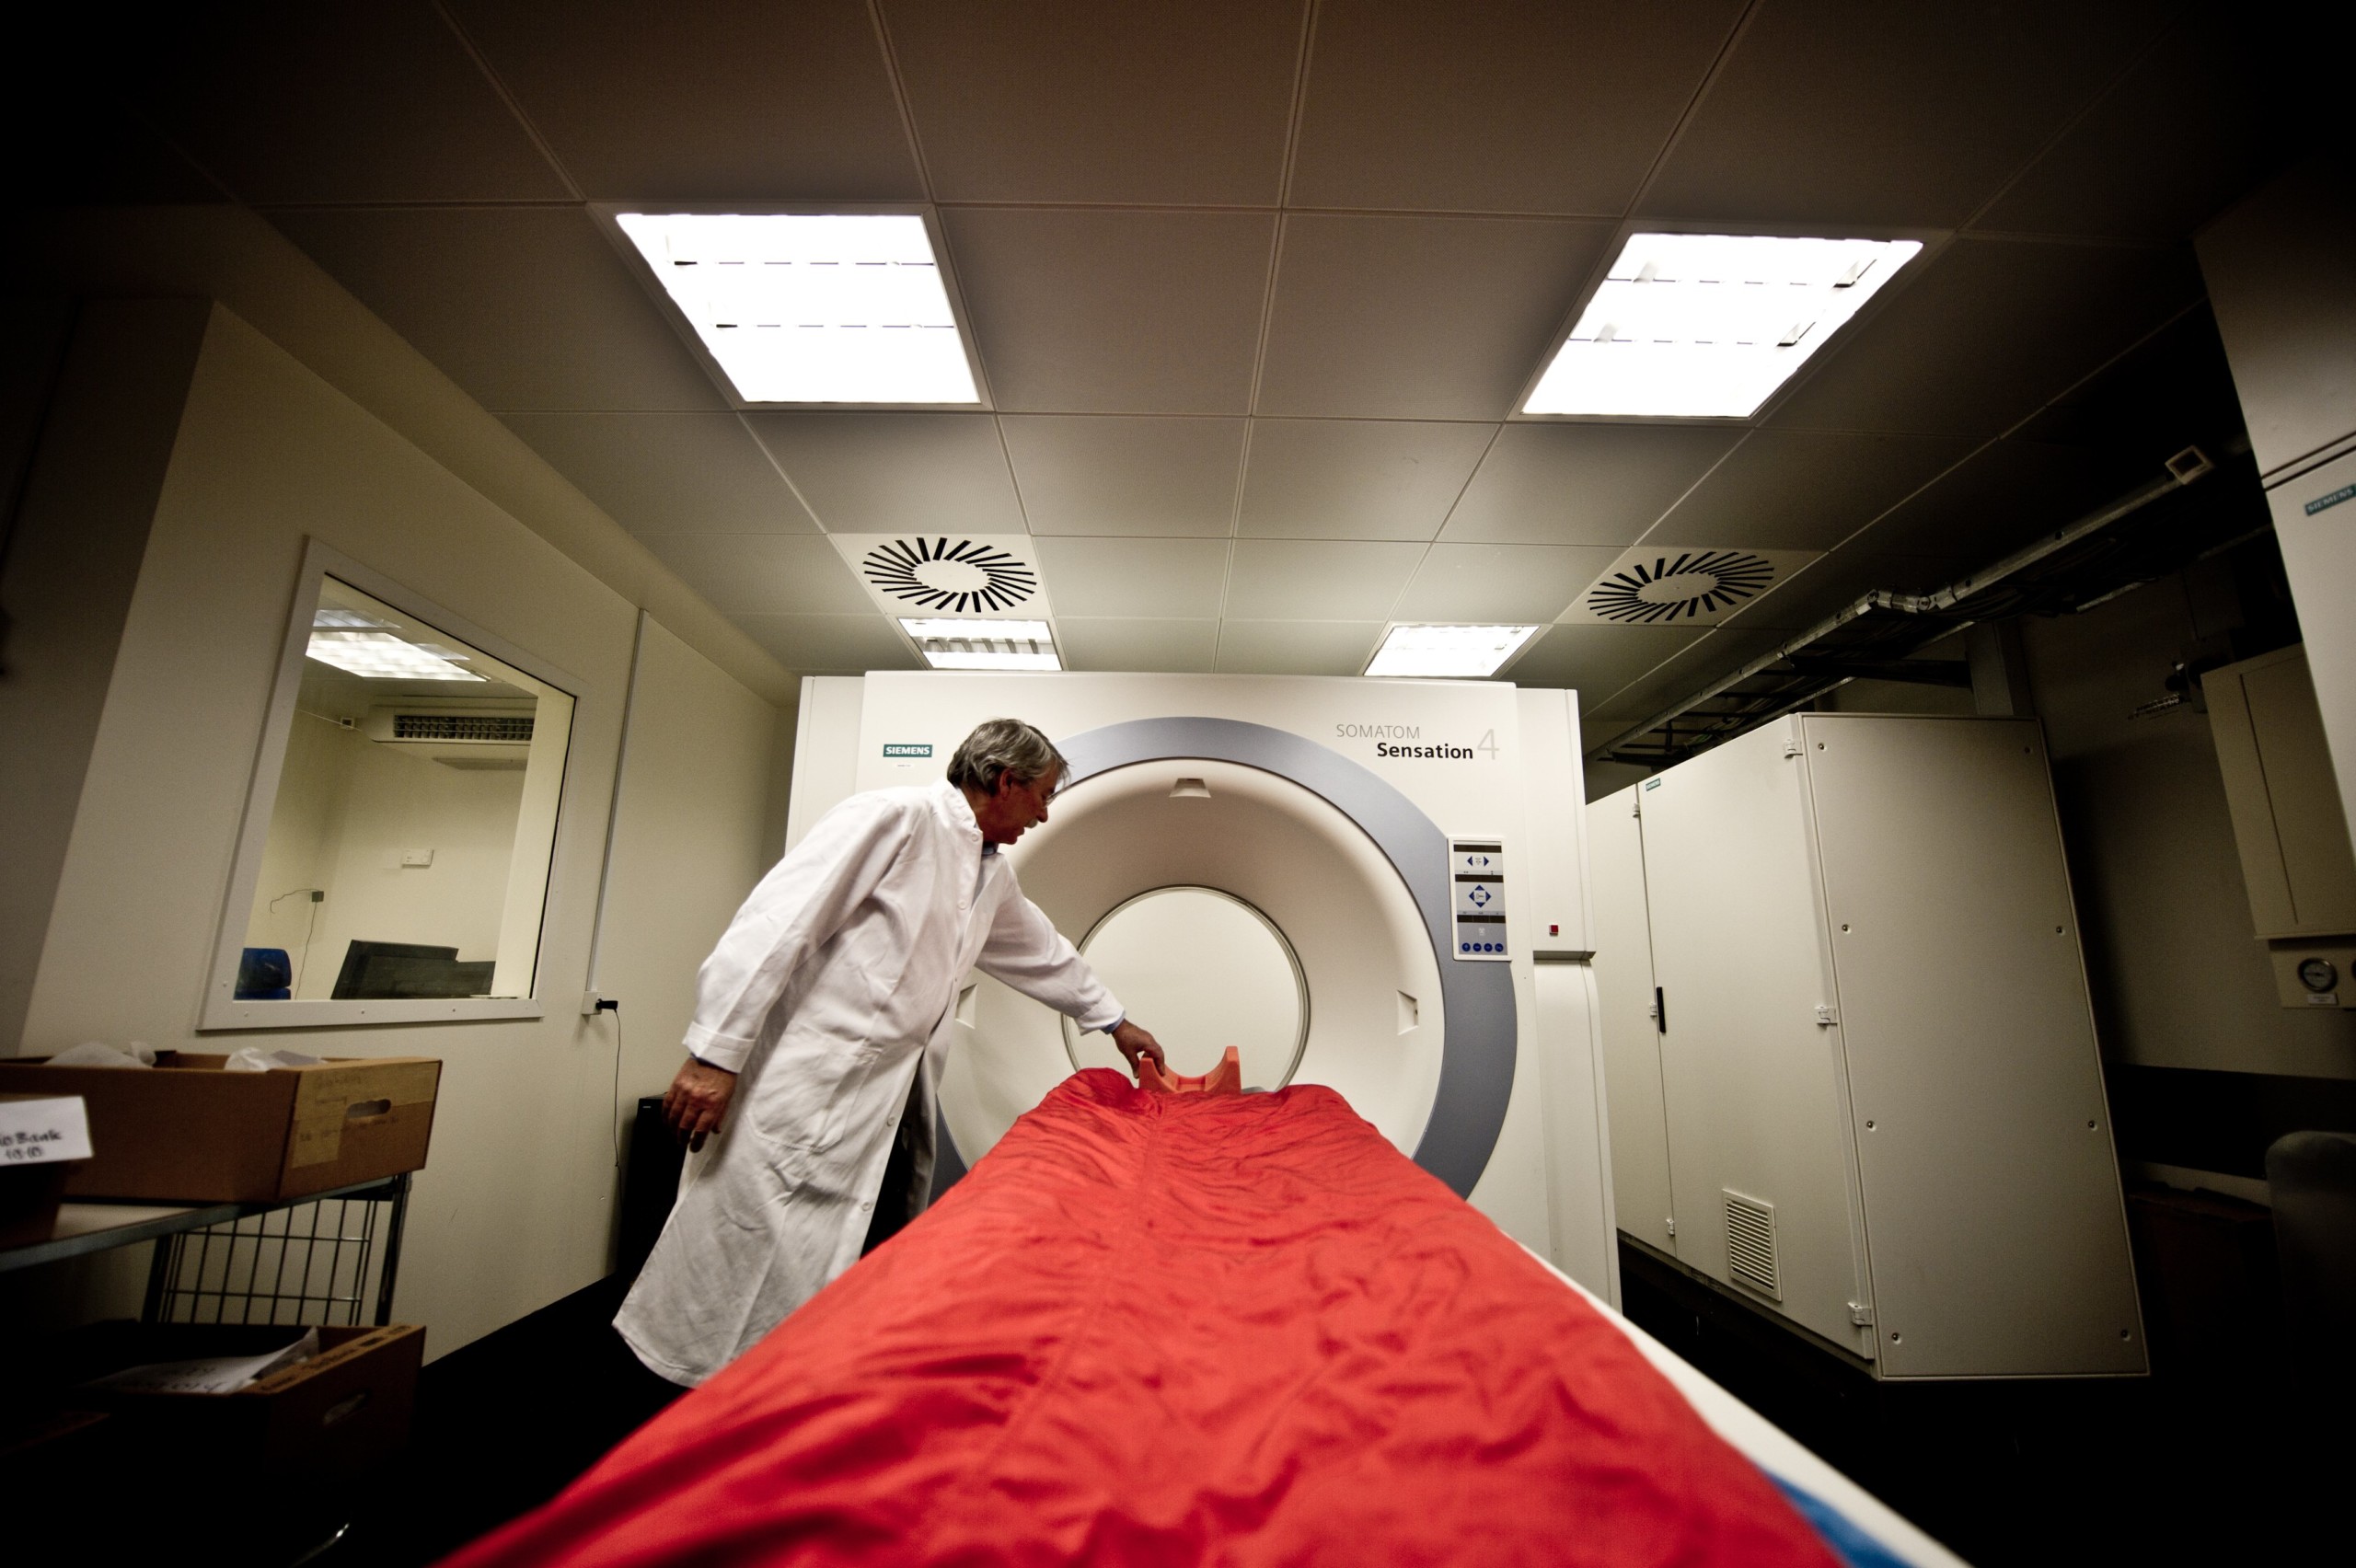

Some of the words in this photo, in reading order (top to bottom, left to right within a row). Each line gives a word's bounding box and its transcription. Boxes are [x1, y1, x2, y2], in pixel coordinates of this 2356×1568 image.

[2306, 487, 2354, 513] SIEMENS
[1335, 723, 1421, 740] SOMATOM
[885, 745, 930, 755] SIEMENS
[1377, 742, 1473, 760] Sensation
[1476, 728, 1501, 761] 4
